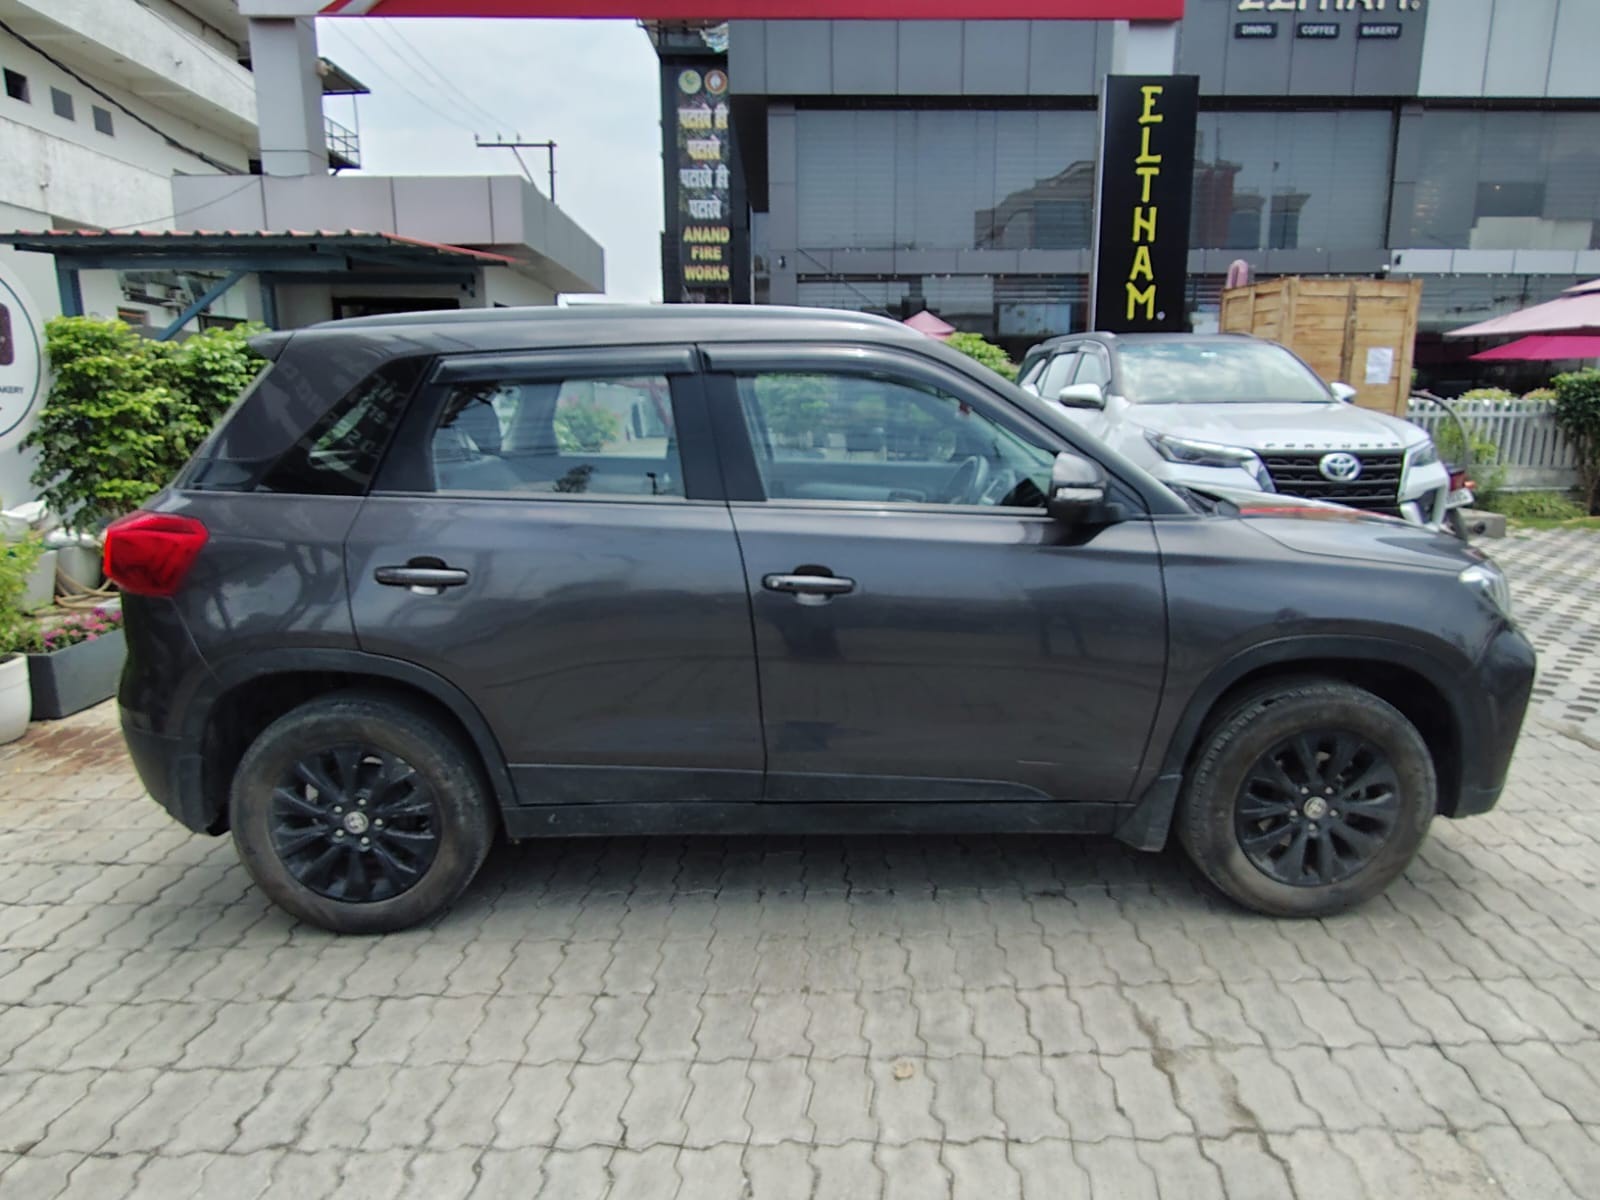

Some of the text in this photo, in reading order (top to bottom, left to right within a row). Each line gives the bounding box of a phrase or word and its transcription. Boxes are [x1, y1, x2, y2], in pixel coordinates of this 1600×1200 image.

[1301, 25, 1336, 35] COFFEE
[1362, 25, 1398, 35] BAKERY
[683, 226, 730, 243] ANAND
[691, 245, 722, 260] FIRE
[684, 265, 730, 281] WORKS
